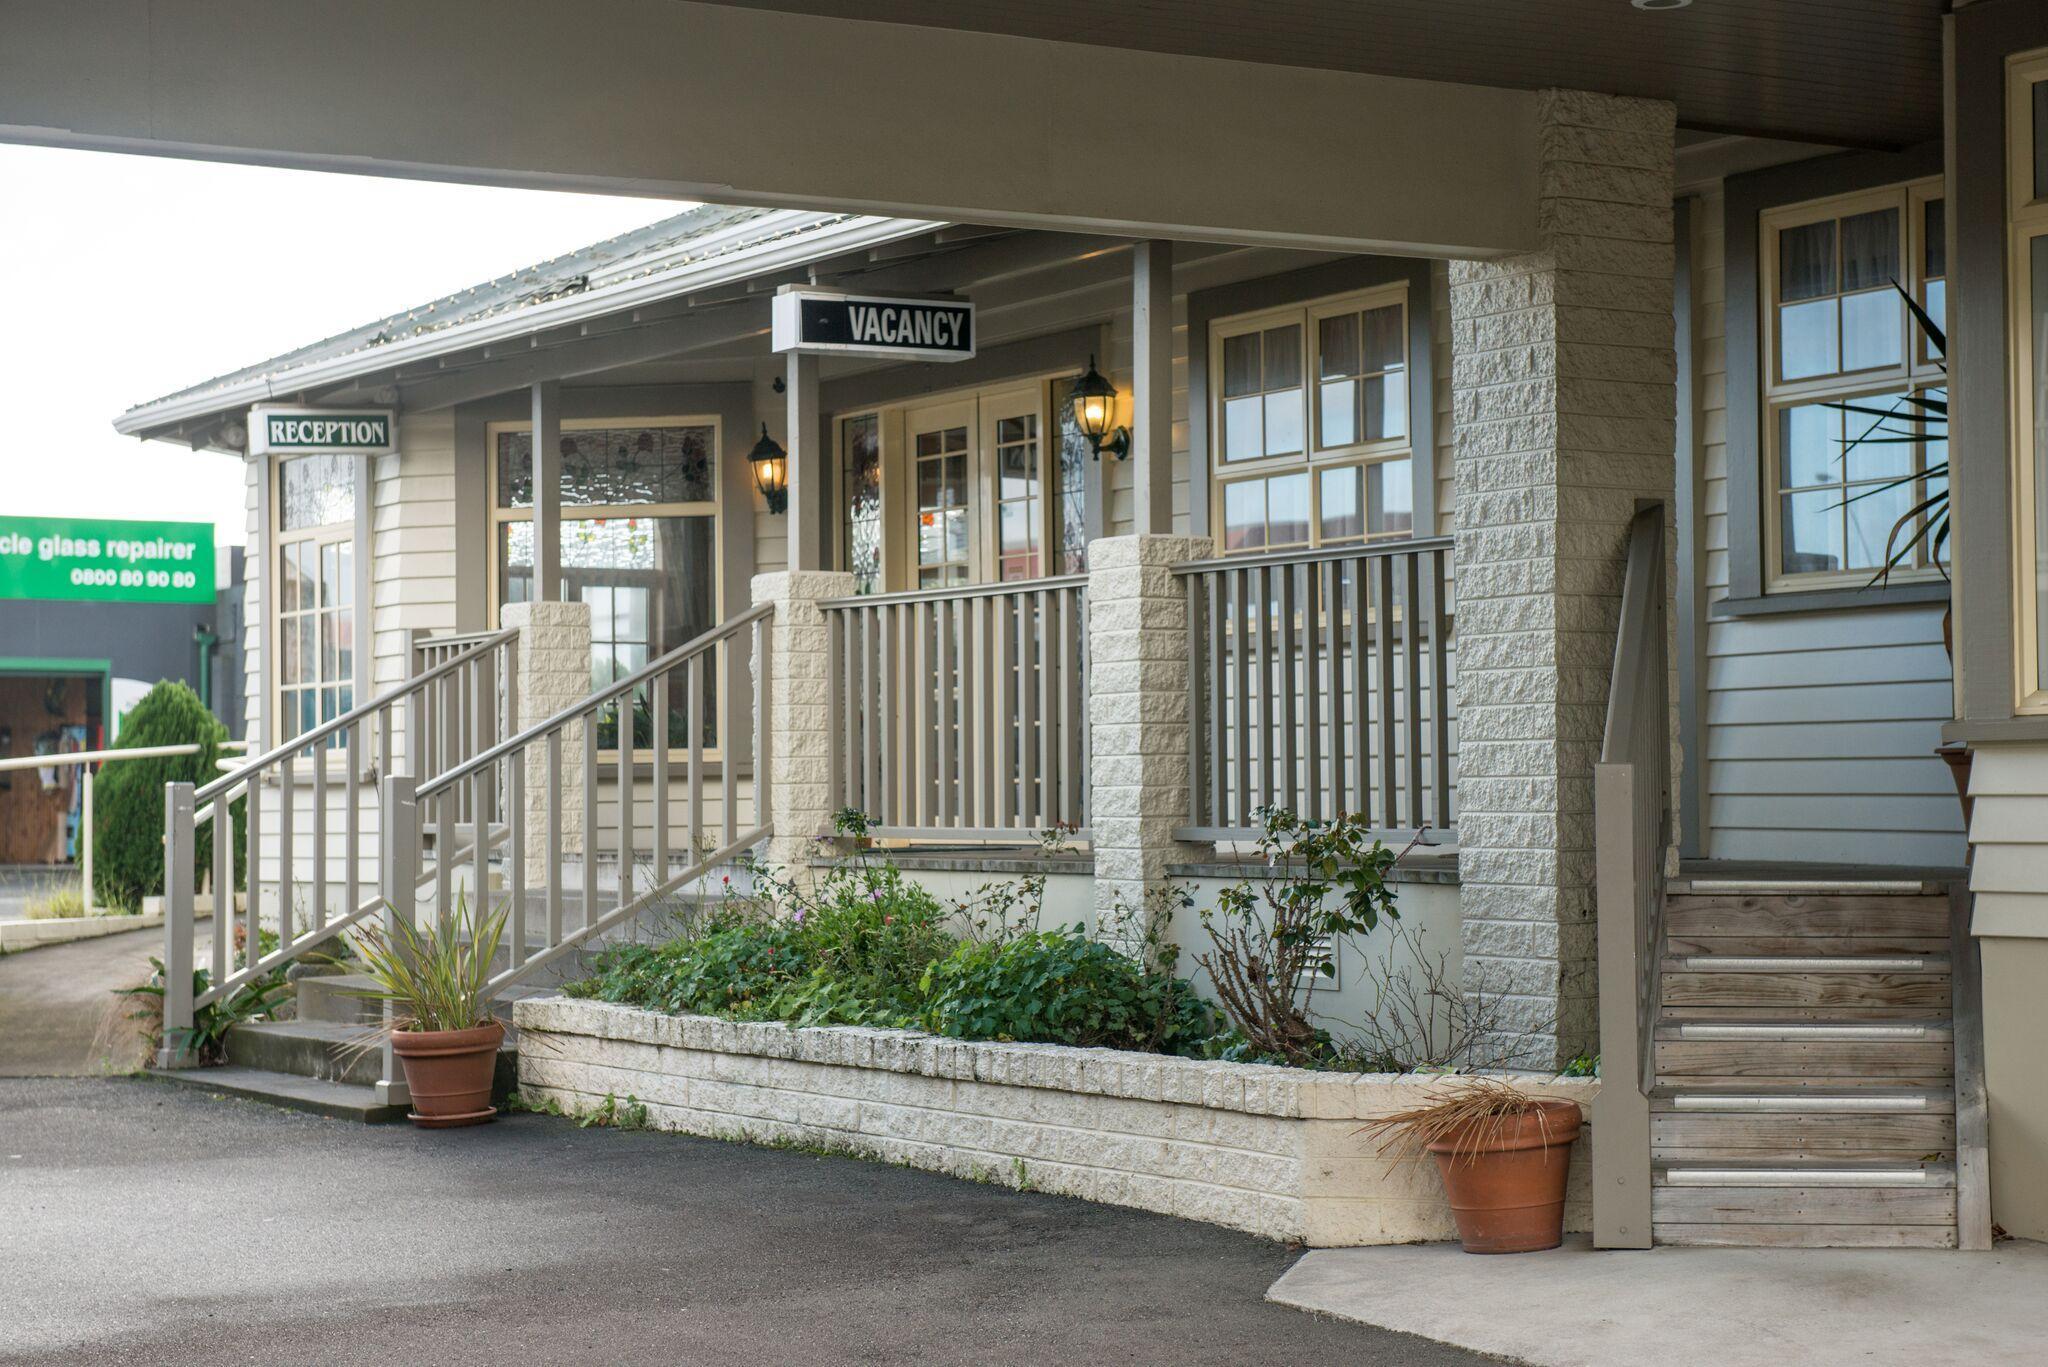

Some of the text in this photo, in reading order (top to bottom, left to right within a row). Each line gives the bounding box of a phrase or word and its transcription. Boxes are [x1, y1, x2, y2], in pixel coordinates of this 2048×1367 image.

[848, 306, 964, 346] VACANCY
[270, 420, 386, 444] RECEPTION
[38, 534, 101, 561] glass
[106, 537, 196, 563] repairer
[70, 568, 196, 588] 0800 80 90 80
